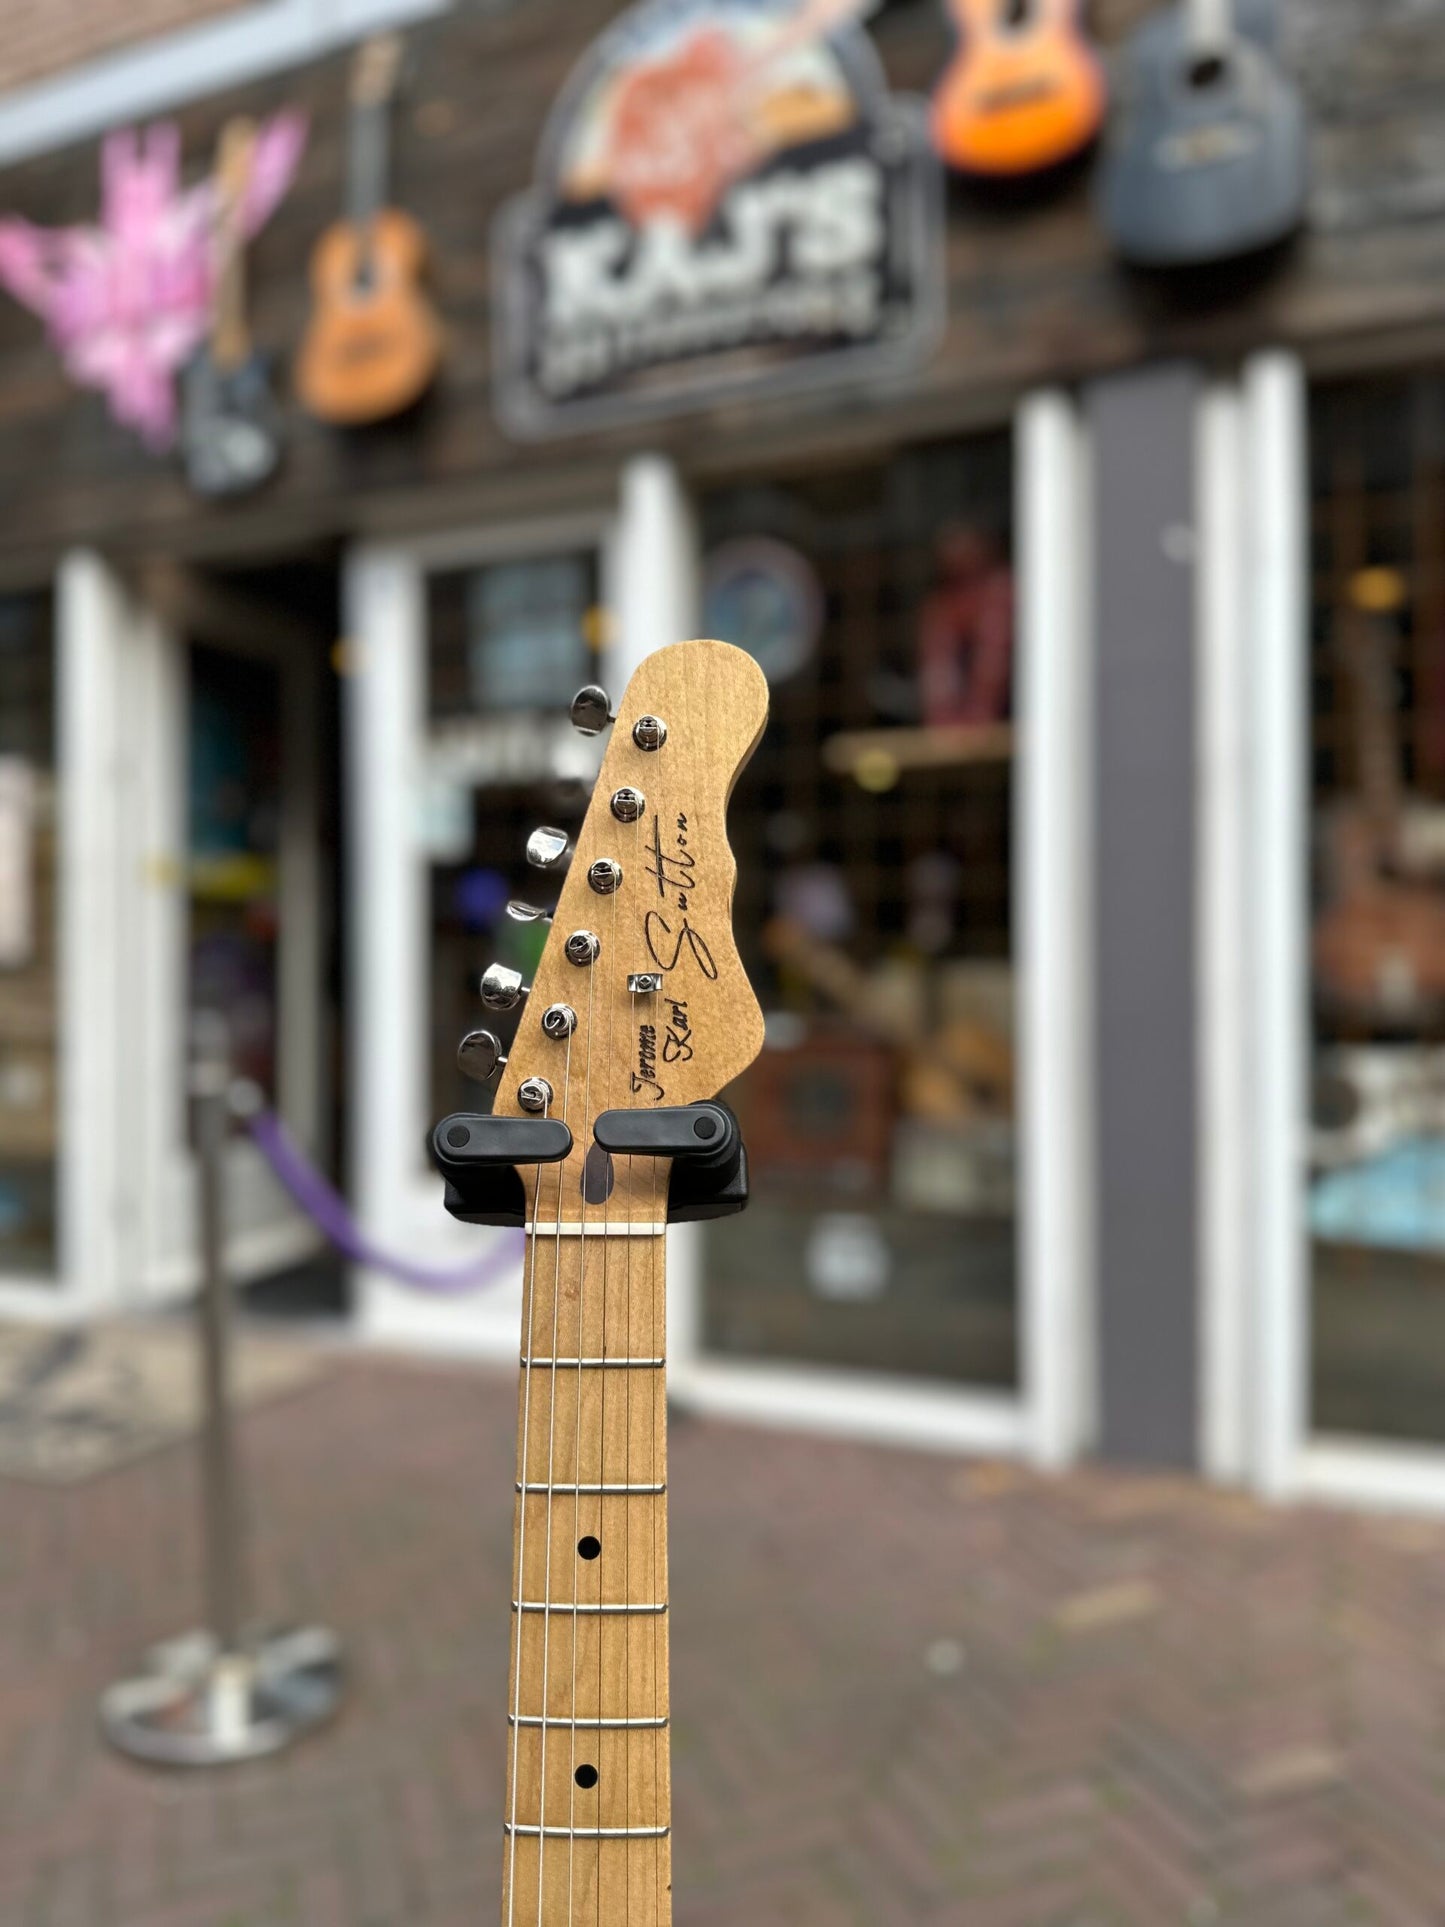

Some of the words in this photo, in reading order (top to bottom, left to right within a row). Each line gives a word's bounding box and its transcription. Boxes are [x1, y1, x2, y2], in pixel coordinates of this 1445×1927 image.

[644, 812, 718, 980] Sutton
[630, 1024, 665, 1101] Jerome
[662, 997, 694, 1063] Karl
